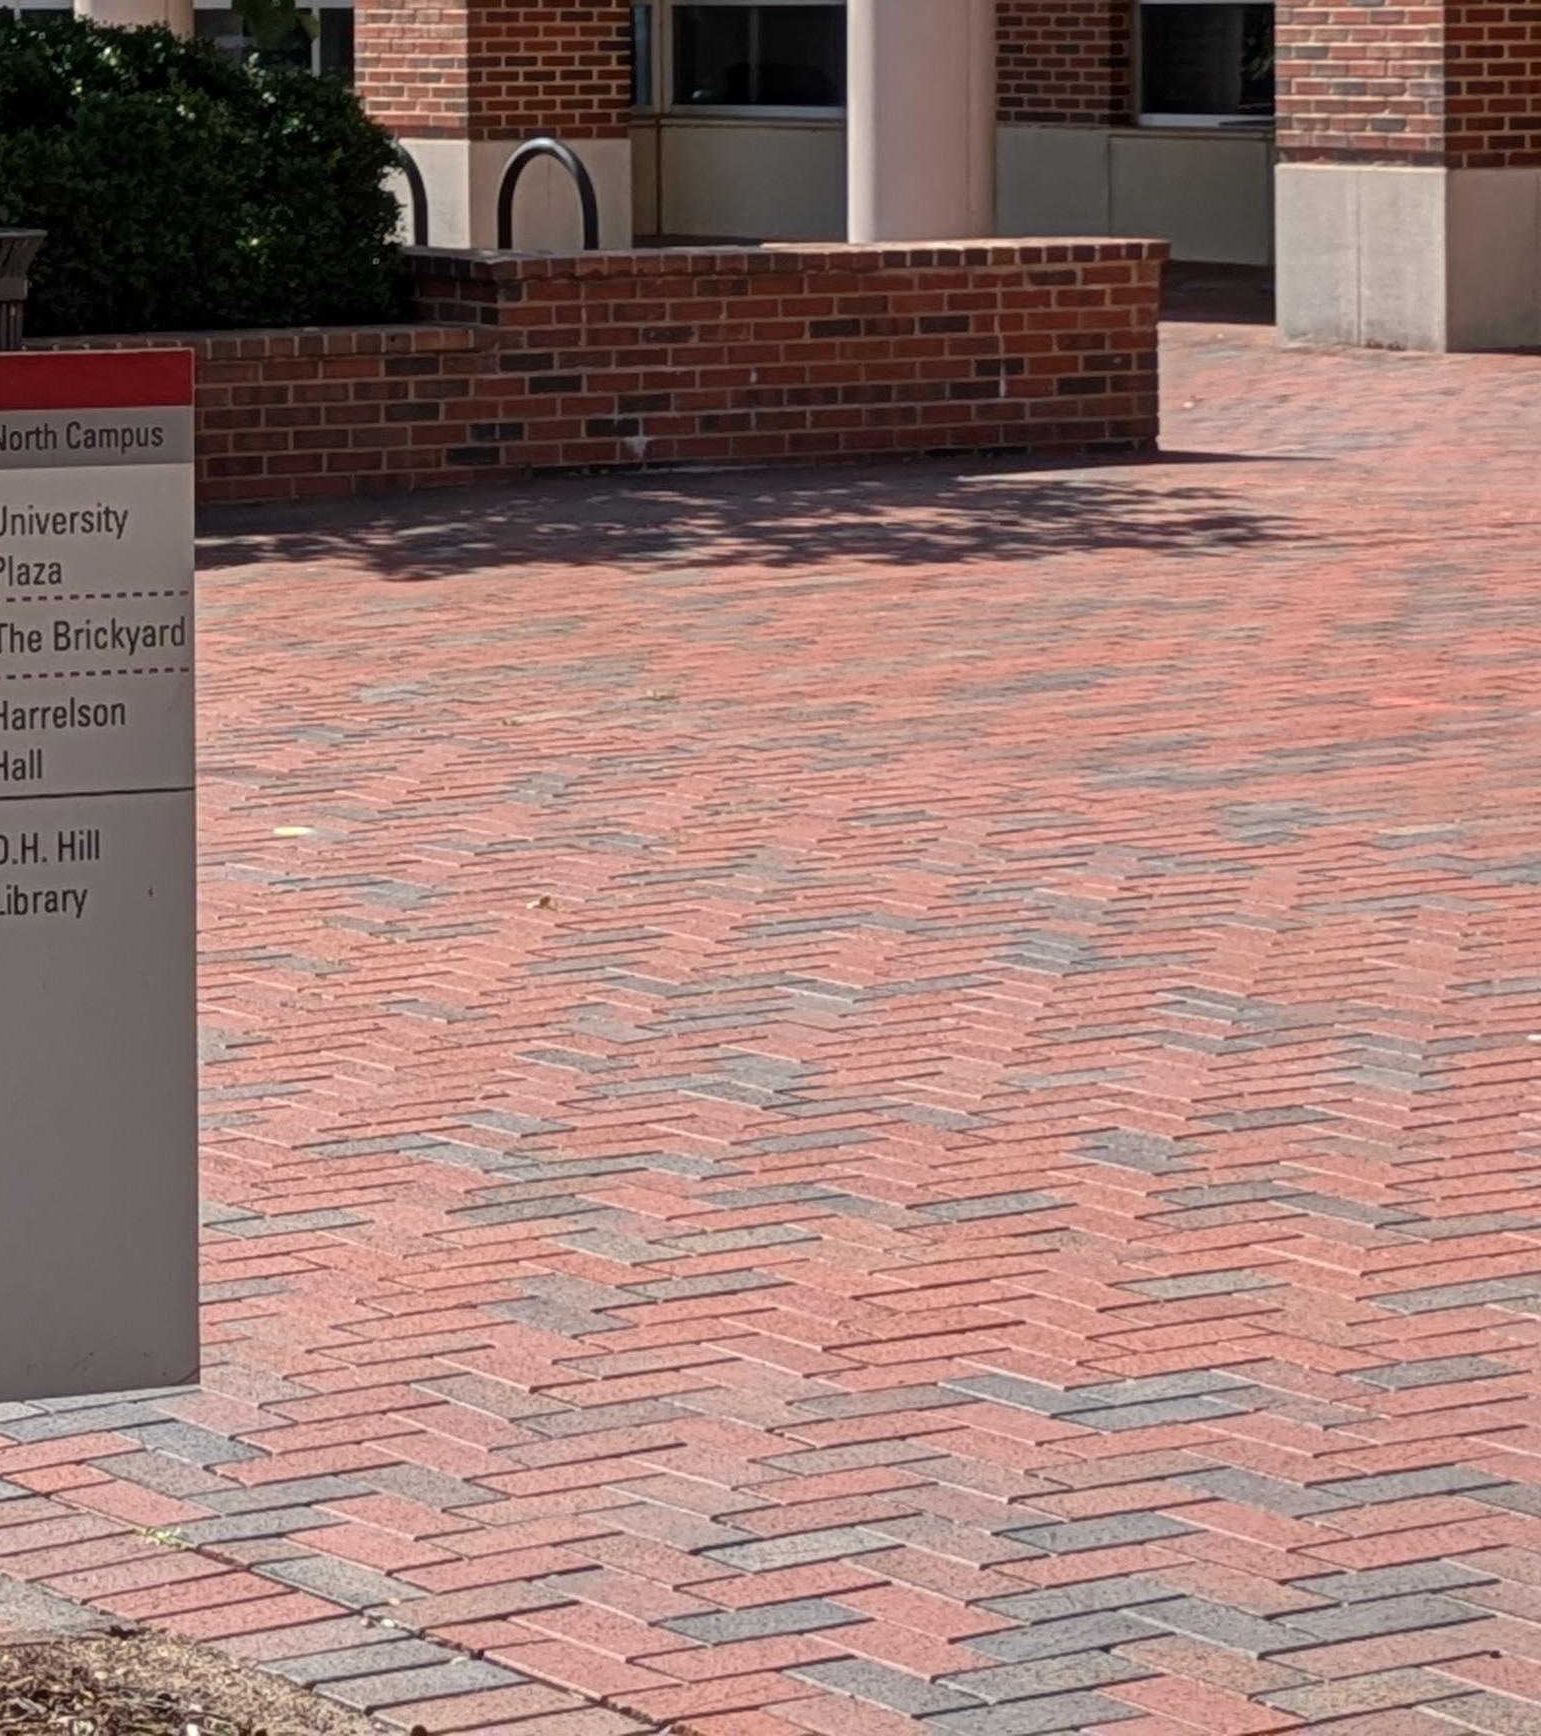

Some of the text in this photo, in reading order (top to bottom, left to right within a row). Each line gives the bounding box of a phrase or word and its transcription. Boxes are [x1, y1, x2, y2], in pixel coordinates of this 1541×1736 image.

[66, 421, 165, 454] Campus
[53, 615, 187, 656] Brickyard
[58, 829, 101, 863] Hill
